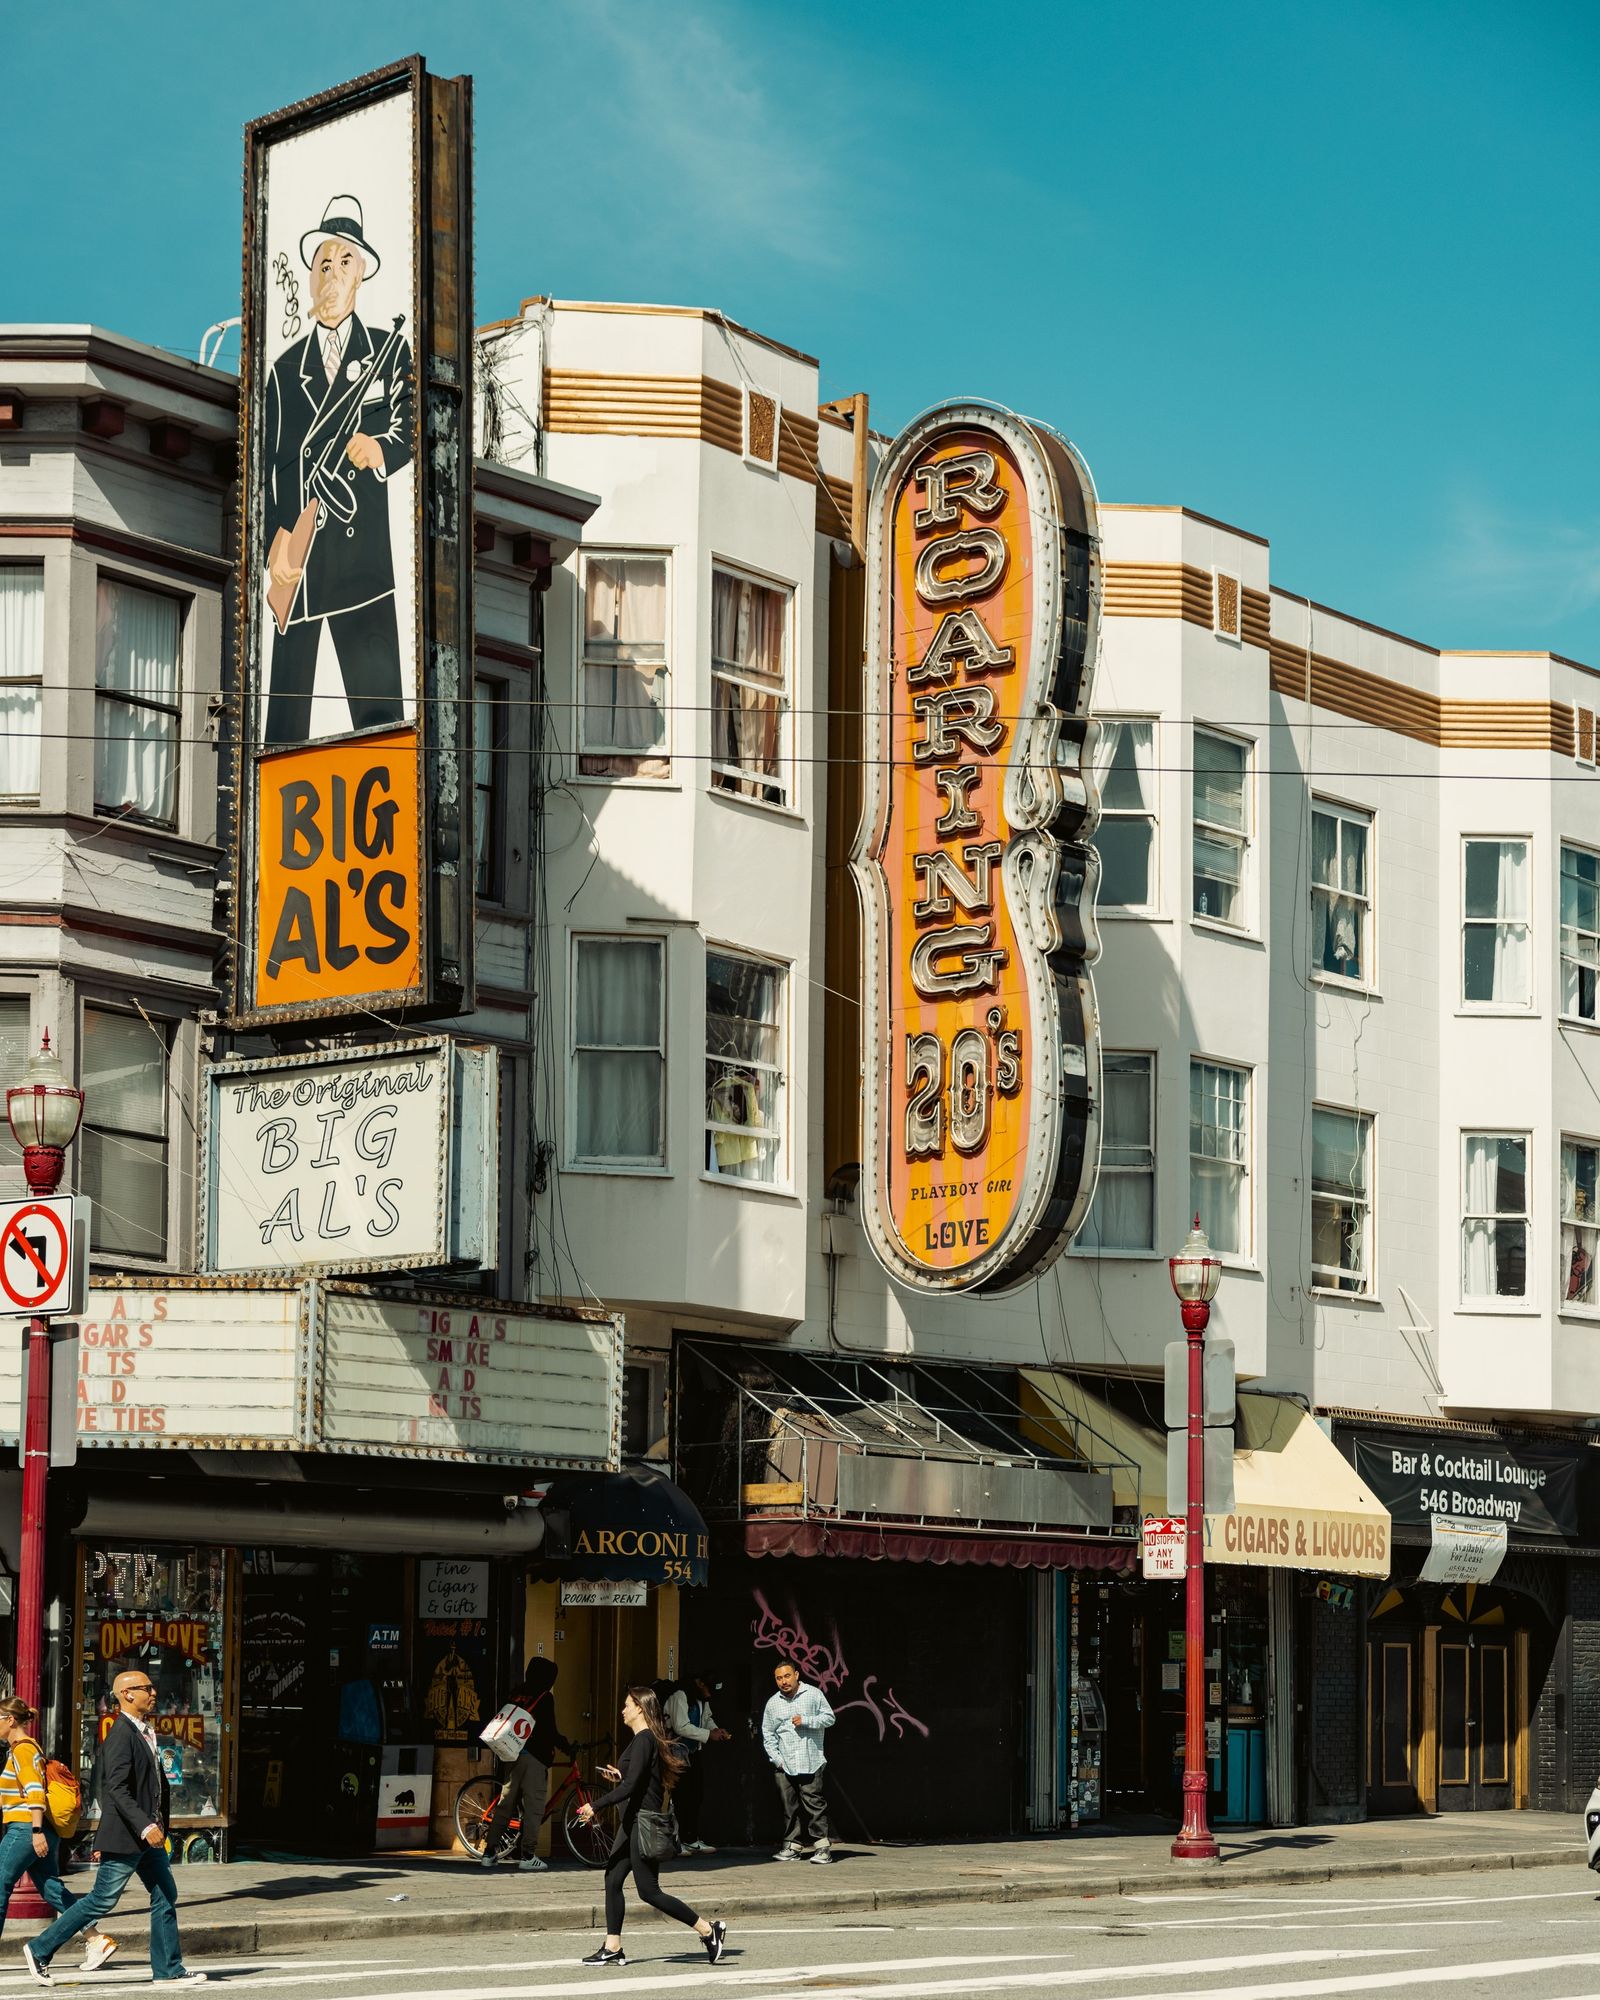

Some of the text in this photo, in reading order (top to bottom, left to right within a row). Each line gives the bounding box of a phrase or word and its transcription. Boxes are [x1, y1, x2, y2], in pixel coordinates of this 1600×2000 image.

[906, 449, 1015, 998] ROARING
[278, 765, 401, 871] BIG
[265, 867, 411, 981] AL'S
[232, 1060, 434, 1114] The Original
[255, 1104, 399, 1175] BIG
[910, 1178, 1013, 1201] PLAYBOY GIRL
[258, 1174, 404, 1245] AL'S
[924, 1217, 990, 1251] LOVE
[427, 1338, 490, 1367] SMKE
[1391, 1449, 1547, 1490] Bar & Cocktail Lounge
[1420, 1488, 1522, 1523] 546 Broadway
[1144, 1533, 1185, 1545] NO STOPPING
[1224, 1514, 1289, 1556] CIGARS
[1295, 1518, 1308, 1557] &
[1312, 1520, 1386, 1561] LIQUORS
[1156, 1548, 1173, 1558] ANY
[1450, 1551, 1484, 1564] For Lease
[1453, 1543, 1486, 1554] Available
[435, 1561, 471, 1578] Fine
[663, 1560, 692, 1580] 554
[1155, 1559, 1174, 1570] TIME
[427, 1579, 479, 1598] Cigars
[562, 1593, 597, 1604] ROOMS
[612, 1594, 644, 1604] RENT
[427, 1597, 477, 1616] & Gifts
[101, 1622, 144, 1660] ONE
[153, 1622, 207, 1664] LOVE
[372, 1630, 400, 1641] ATM
[247, 1664, 261, 1683] GO
[383, 1680, 404, 1688] ATM
